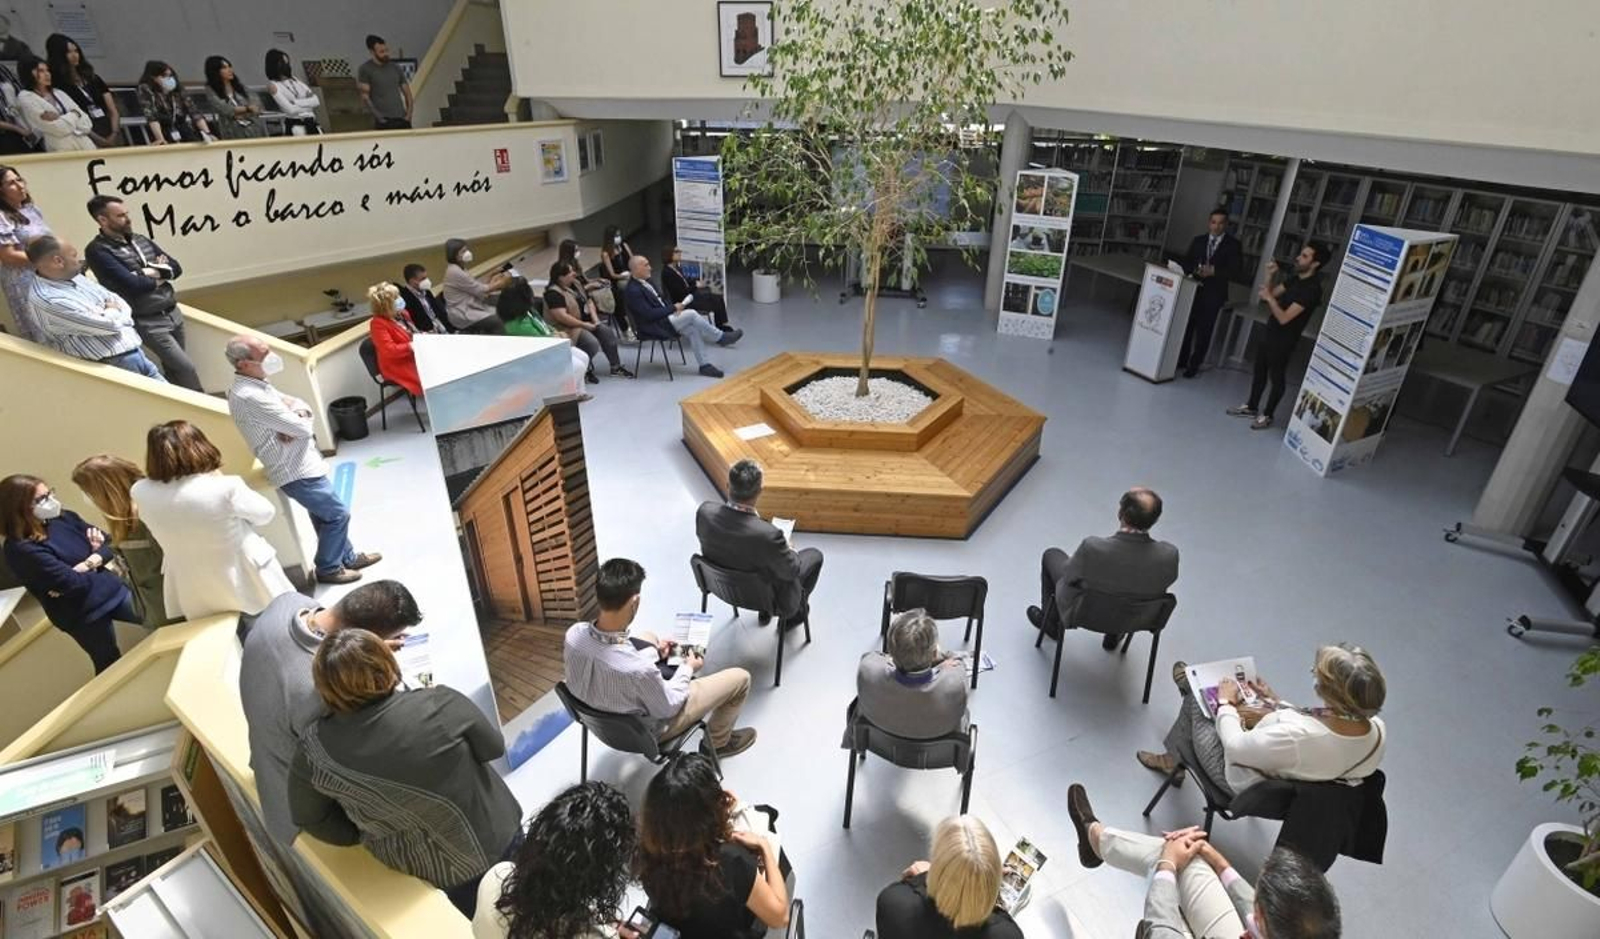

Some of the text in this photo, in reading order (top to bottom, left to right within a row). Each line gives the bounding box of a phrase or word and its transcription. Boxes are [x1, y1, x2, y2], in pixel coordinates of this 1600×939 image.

[87, 143, 395, 199] Fomos ficando sós
[141, 171, 492, 241] Mar o barco e mais nós
